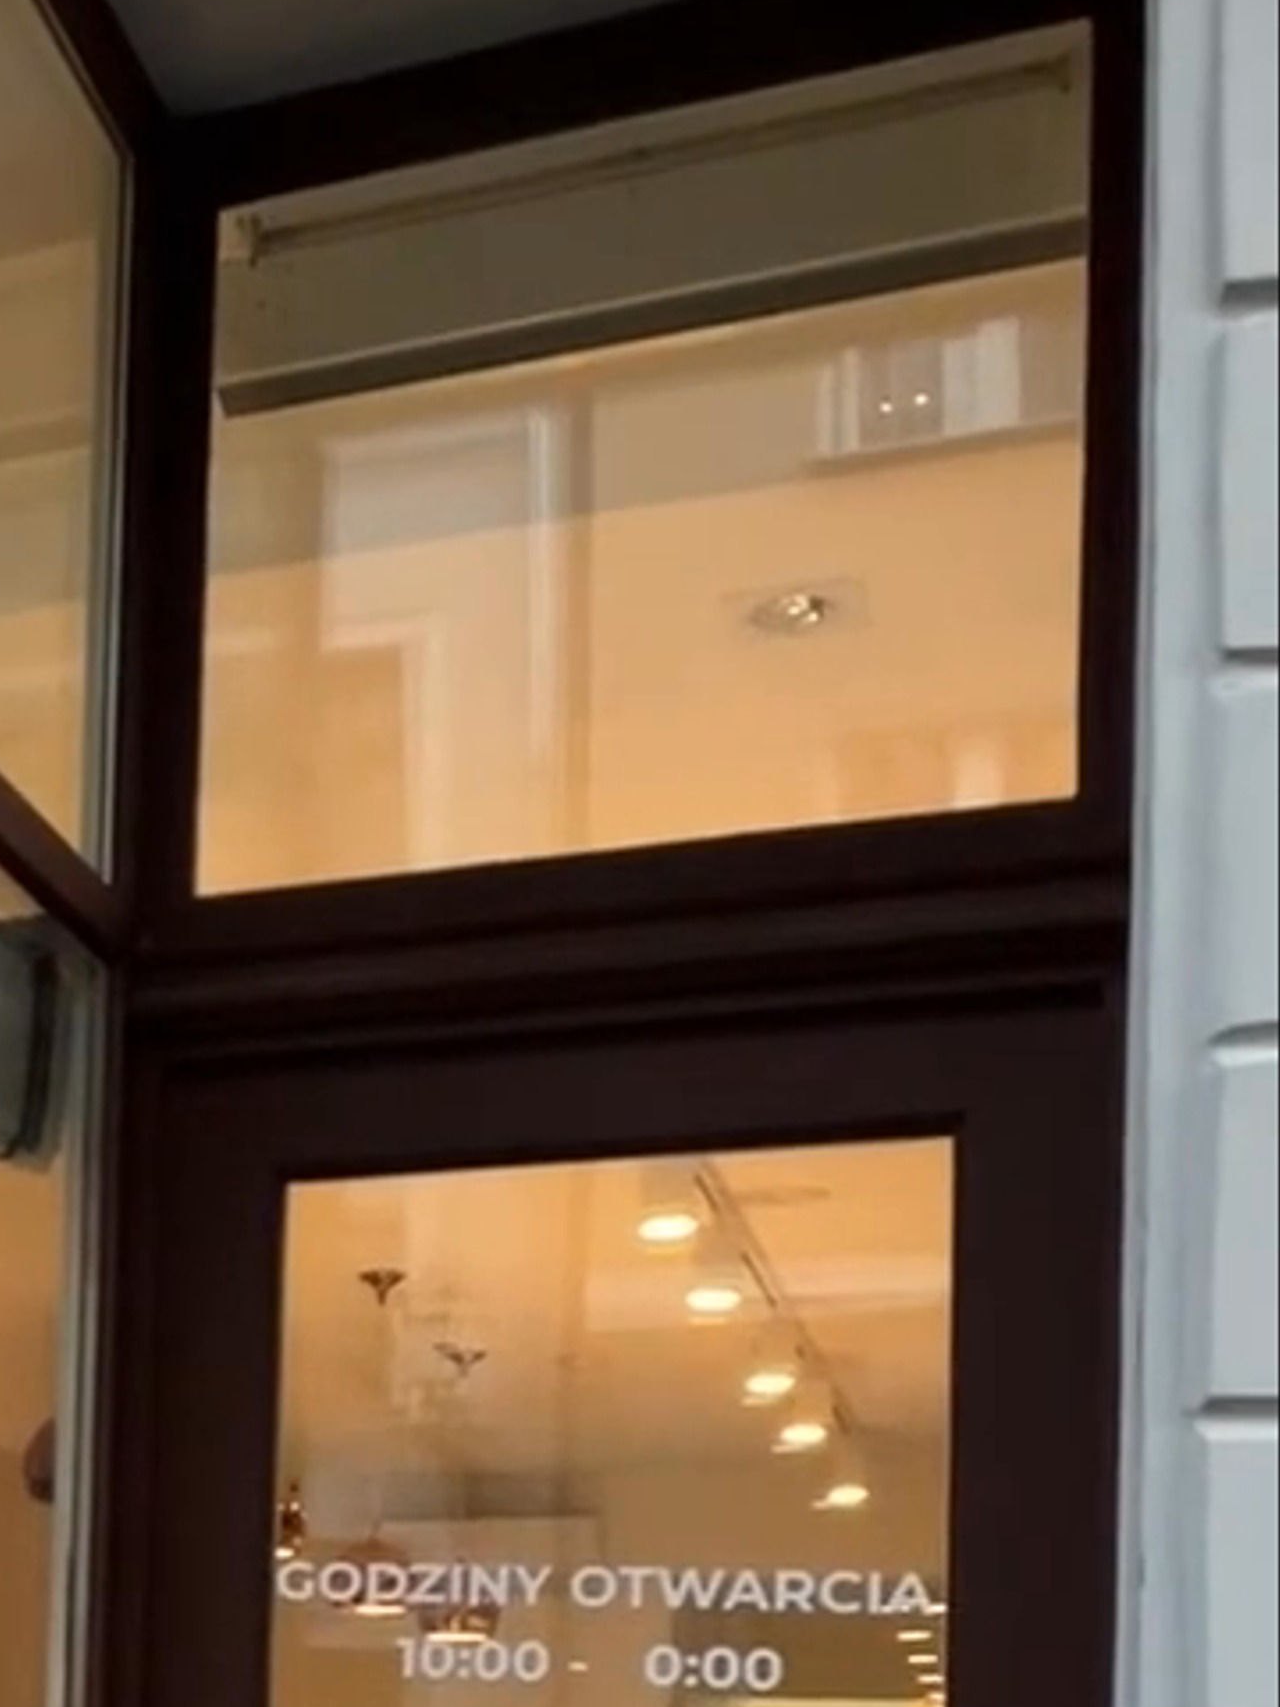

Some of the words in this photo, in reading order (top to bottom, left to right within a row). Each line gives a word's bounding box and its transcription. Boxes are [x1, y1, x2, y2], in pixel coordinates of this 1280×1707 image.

[275, 1560, 551, 1606] GODZINY
[570, 1563, 930, 1614] OTWARCIA
[397, 1637, 550, 1683] 10:00
